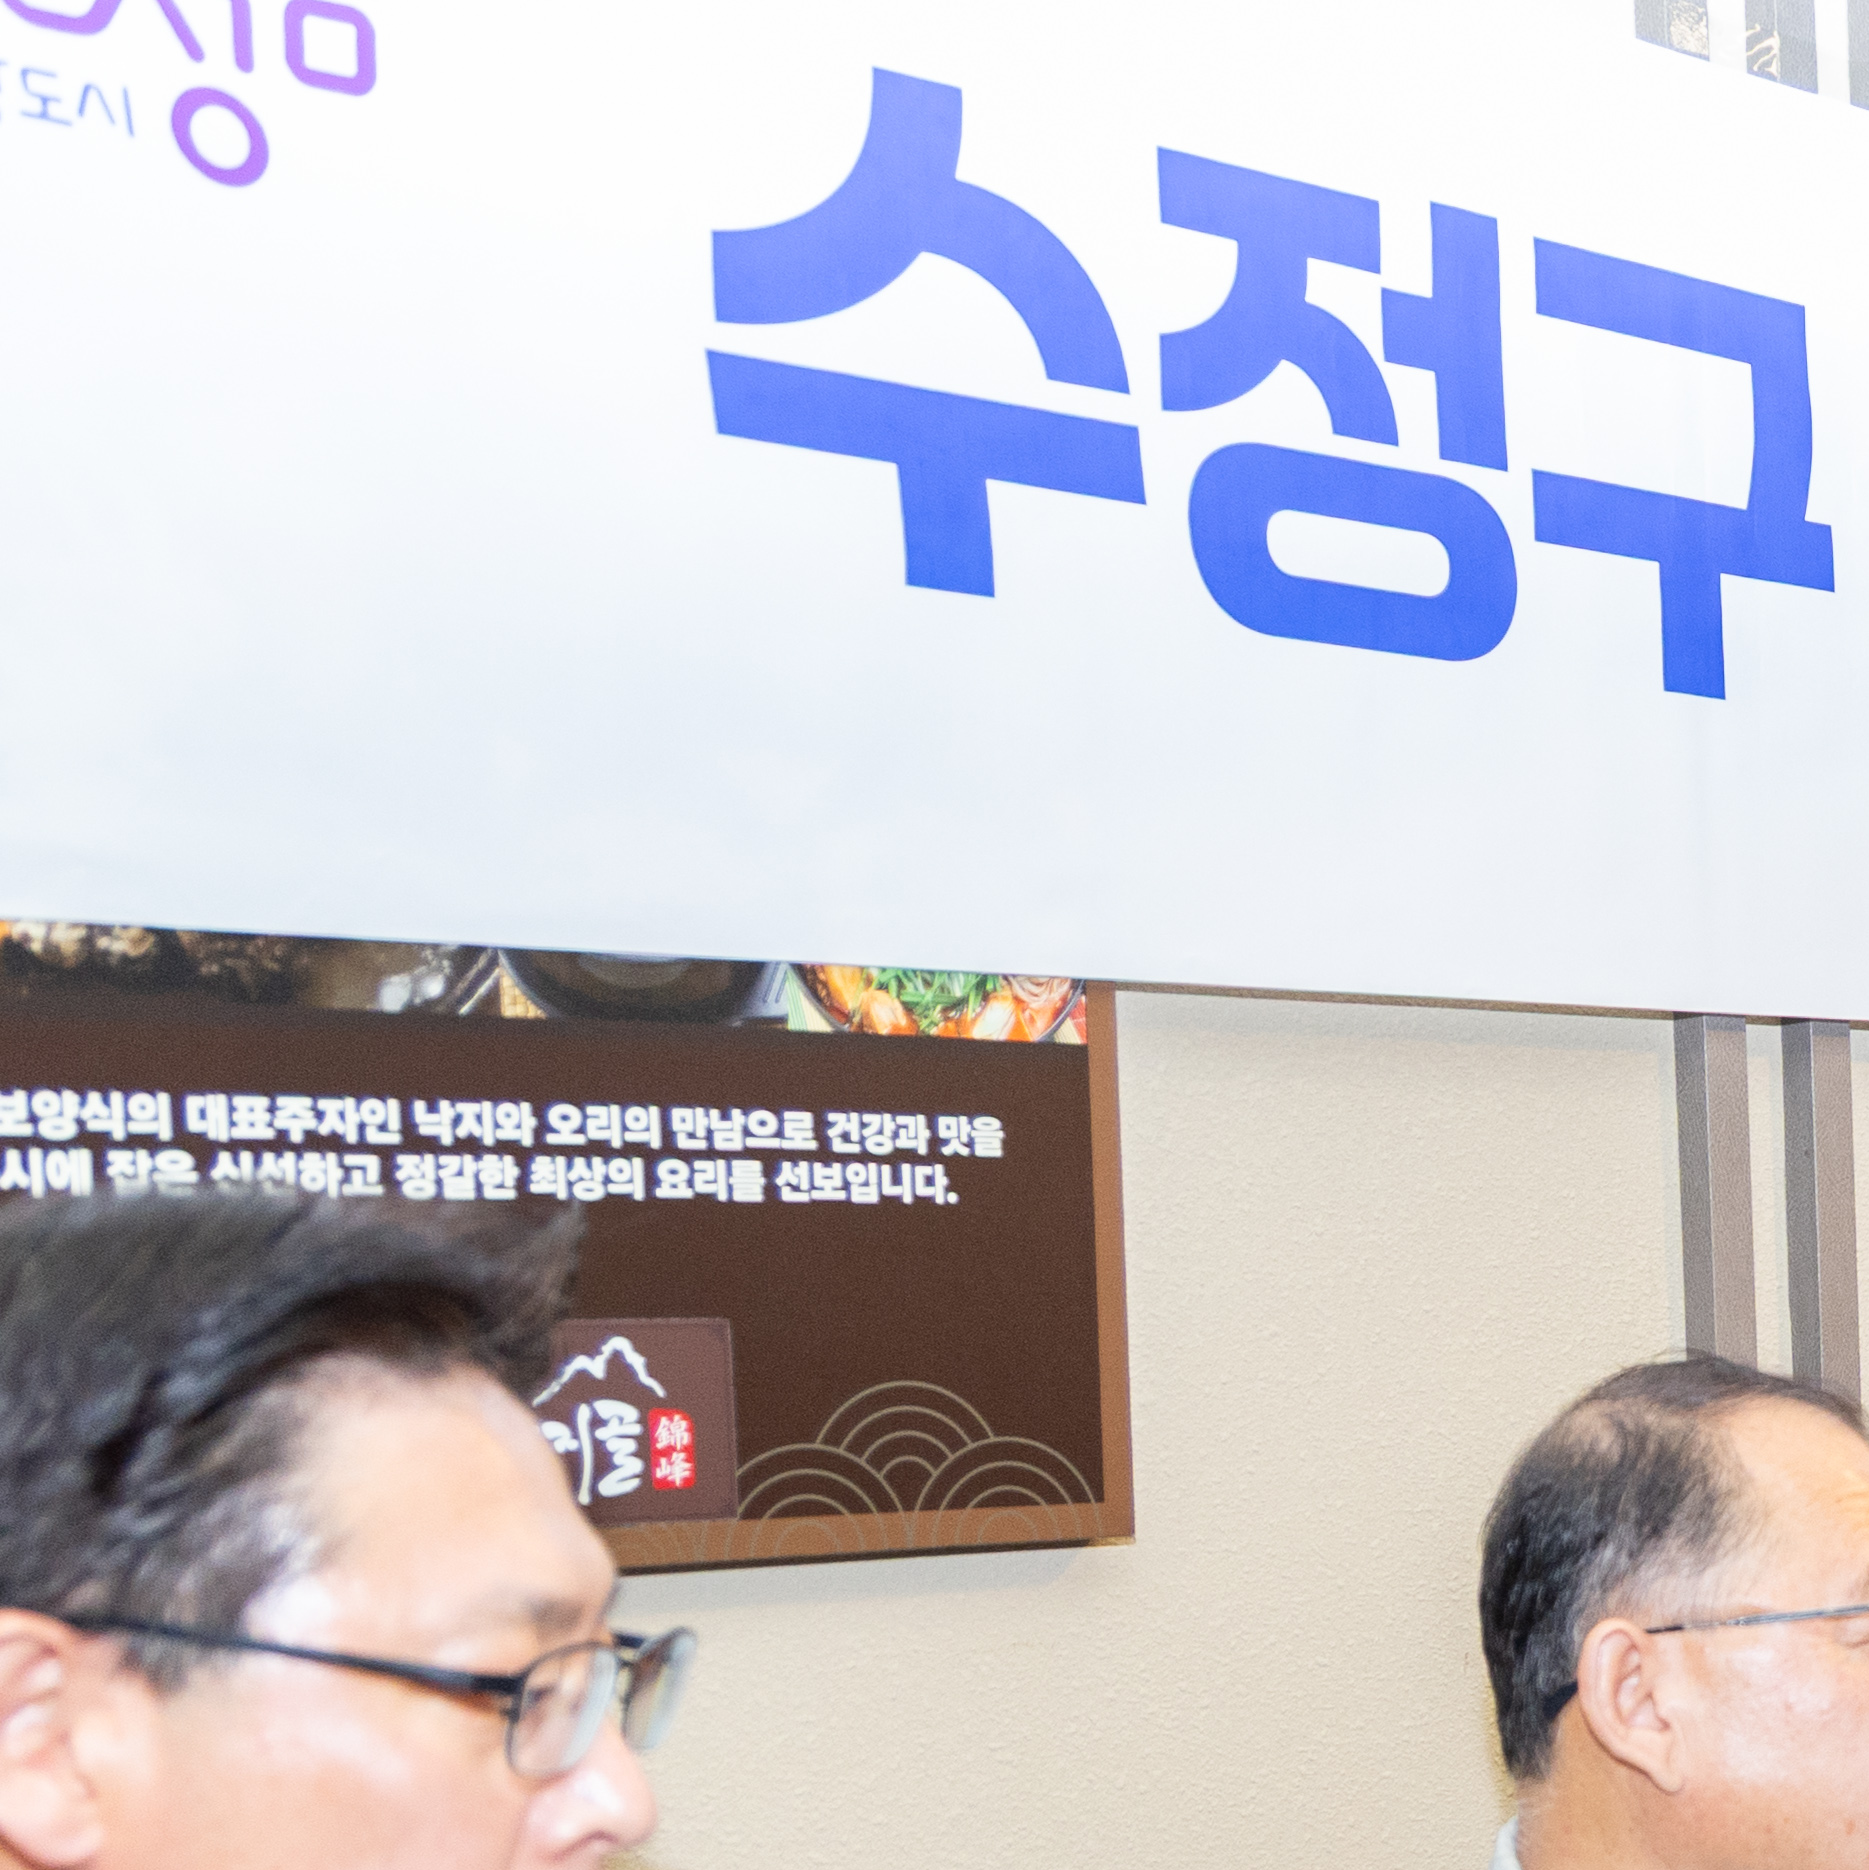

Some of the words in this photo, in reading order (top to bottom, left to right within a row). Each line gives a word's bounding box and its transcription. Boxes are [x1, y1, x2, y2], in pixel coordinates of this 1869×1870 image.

[0, 60, 135, 138] 도시
[706, 66, 1835, 699] 수정구
[0, 1088, 174, 1142] 보양식의
[184, 1093, 403, 1144] 대표주자인
[412, 1099, 536, 1147] 낙지와
[545, 1103, 662, 1149] 오리의
[671, 1106, 818, 1151] 만남으로
[826, 1110, 930, 1155] 건강과
[937, 1115, 1004, 1157] 맛을
[210, 1150, 384, 1199] 신선하고
[395, 1153, 518, 1201] 정갈한
[530, 1156, 645, 1201] 최상의
[655, 1158, 765, 1203] 요리를
[775, 1160, 960, 1204] 선보입니다.
